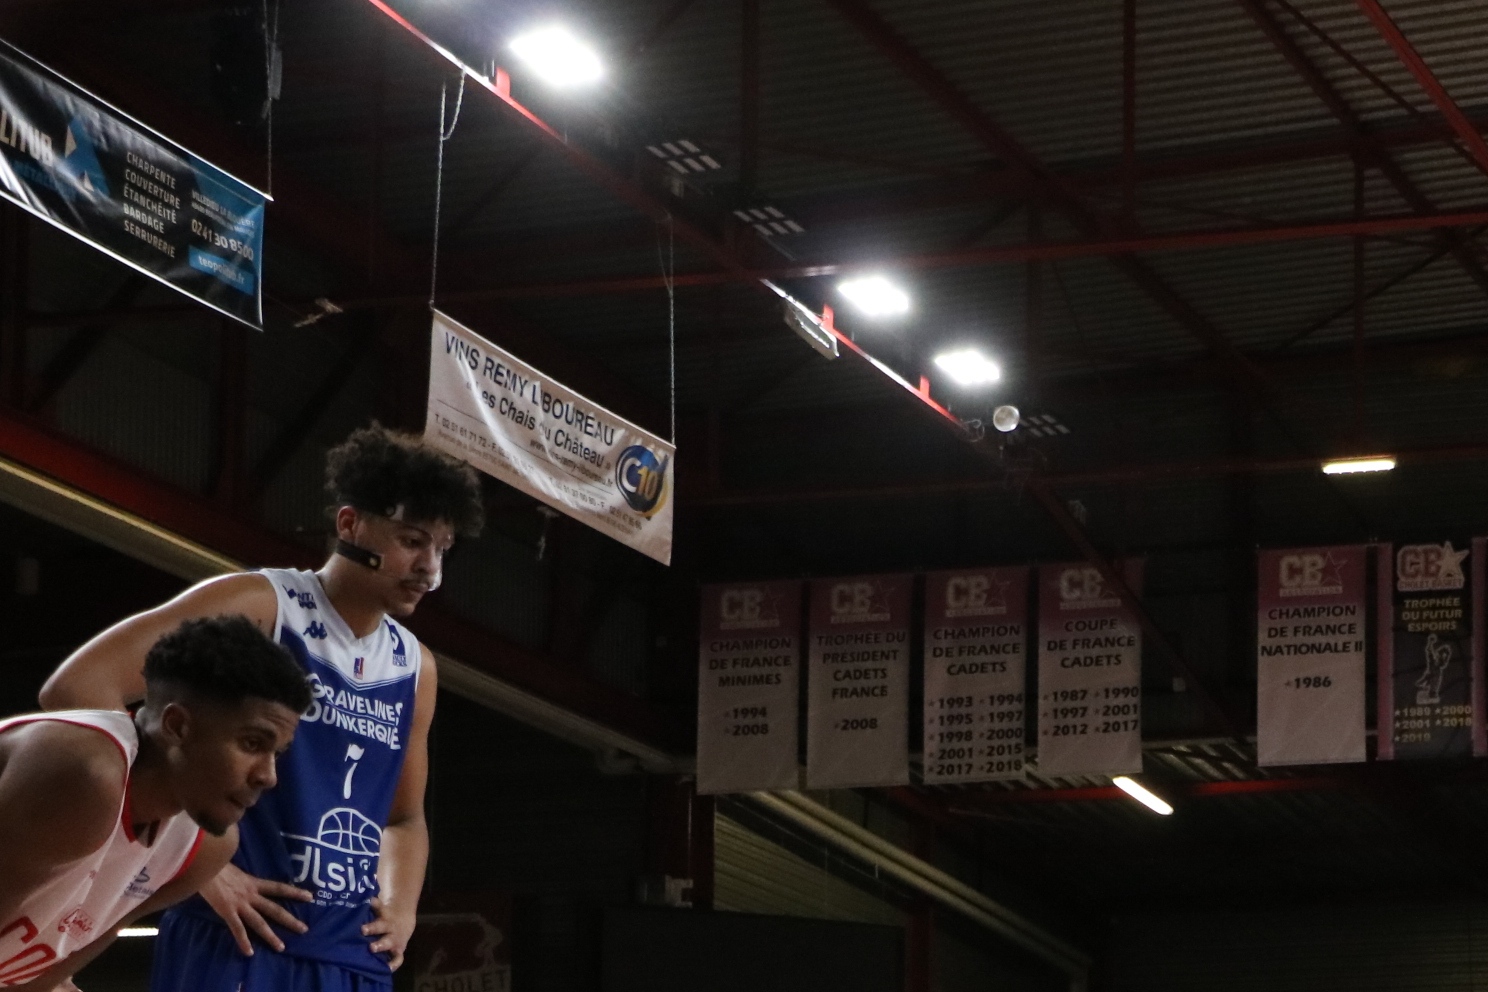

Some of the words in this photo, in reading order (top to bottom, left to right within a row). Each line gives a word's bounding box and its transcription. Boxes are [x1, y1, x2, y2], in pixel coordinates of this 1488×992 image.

[126, 152, 176, 190] CHARPENTE
[125, 169, 181, 209] COUVERTURE
[123, 203, 164, 234] BARDAGE
[124, 220, 176, 258] SERRURERIE
[445, 332, 479, 371] VINS
[483, 356, 528, 398] REMY
[499, 397, 536, 430] Chais
[554, 429, 605, 469] Château
[1268, 605, 1357, 621] CHAMPION
[1402, 610, 1420, 621] DU
[1422, 608, 1463, 620] FUTUR
[933, 625, 1020, 640] CHAMPION
[1064, 618, 1119, 633] COUPE
[1267, 626, 1288, 639] DE
[1293, 622, 1357, 638] FRANCE
[1407, 620, 1457, 632] ESPOIRS
[710, 637, 792, 653] CHAMPION
[886, 632, 907, 644] DU
[1046, 640, 1067, 652] DE
[1072, 636, 1135, 651] FRANCE
[932, 646, 954, 659] DE
[958, 643, 1020, 658] FRANCE
[1260, 641, 1351, 657] NATIONALE
[709, 658, 728, 671] DE
[732, 655, 792, 670] FRANCE
[946, 661, 1007, 676] CADETS
[1060, 653, 1122, 669] CADETS
[718, 673, 782, 688] MINIMES
[833, 668, 888, 682] CADETS
[1294, 675, 1332, 689] 1986
[832, 685, 888, 700] FRANCE
[1053, 689, 1088, 703] 1987
[1103, 686, 1139, 700] 1990
[732, 707, 768, 720] 1994
[988, 711, 1023, 724] 1997
[1053, 706, 1088, 720] 1997
[1102, 704, 1138, 717] 2001
[732, 723, 769, 737] 2008
[840, 718, 879, 732] 2008
[1052, 723, 1088, 737] 2012
[1102, 720, 1138, 734] 2017
[986, 728, 1023, 741] 2000
[937, 747, 973, 760] 2001
[343, 743, 366, 800] 7
[936, 763, 973, 776] 2017
